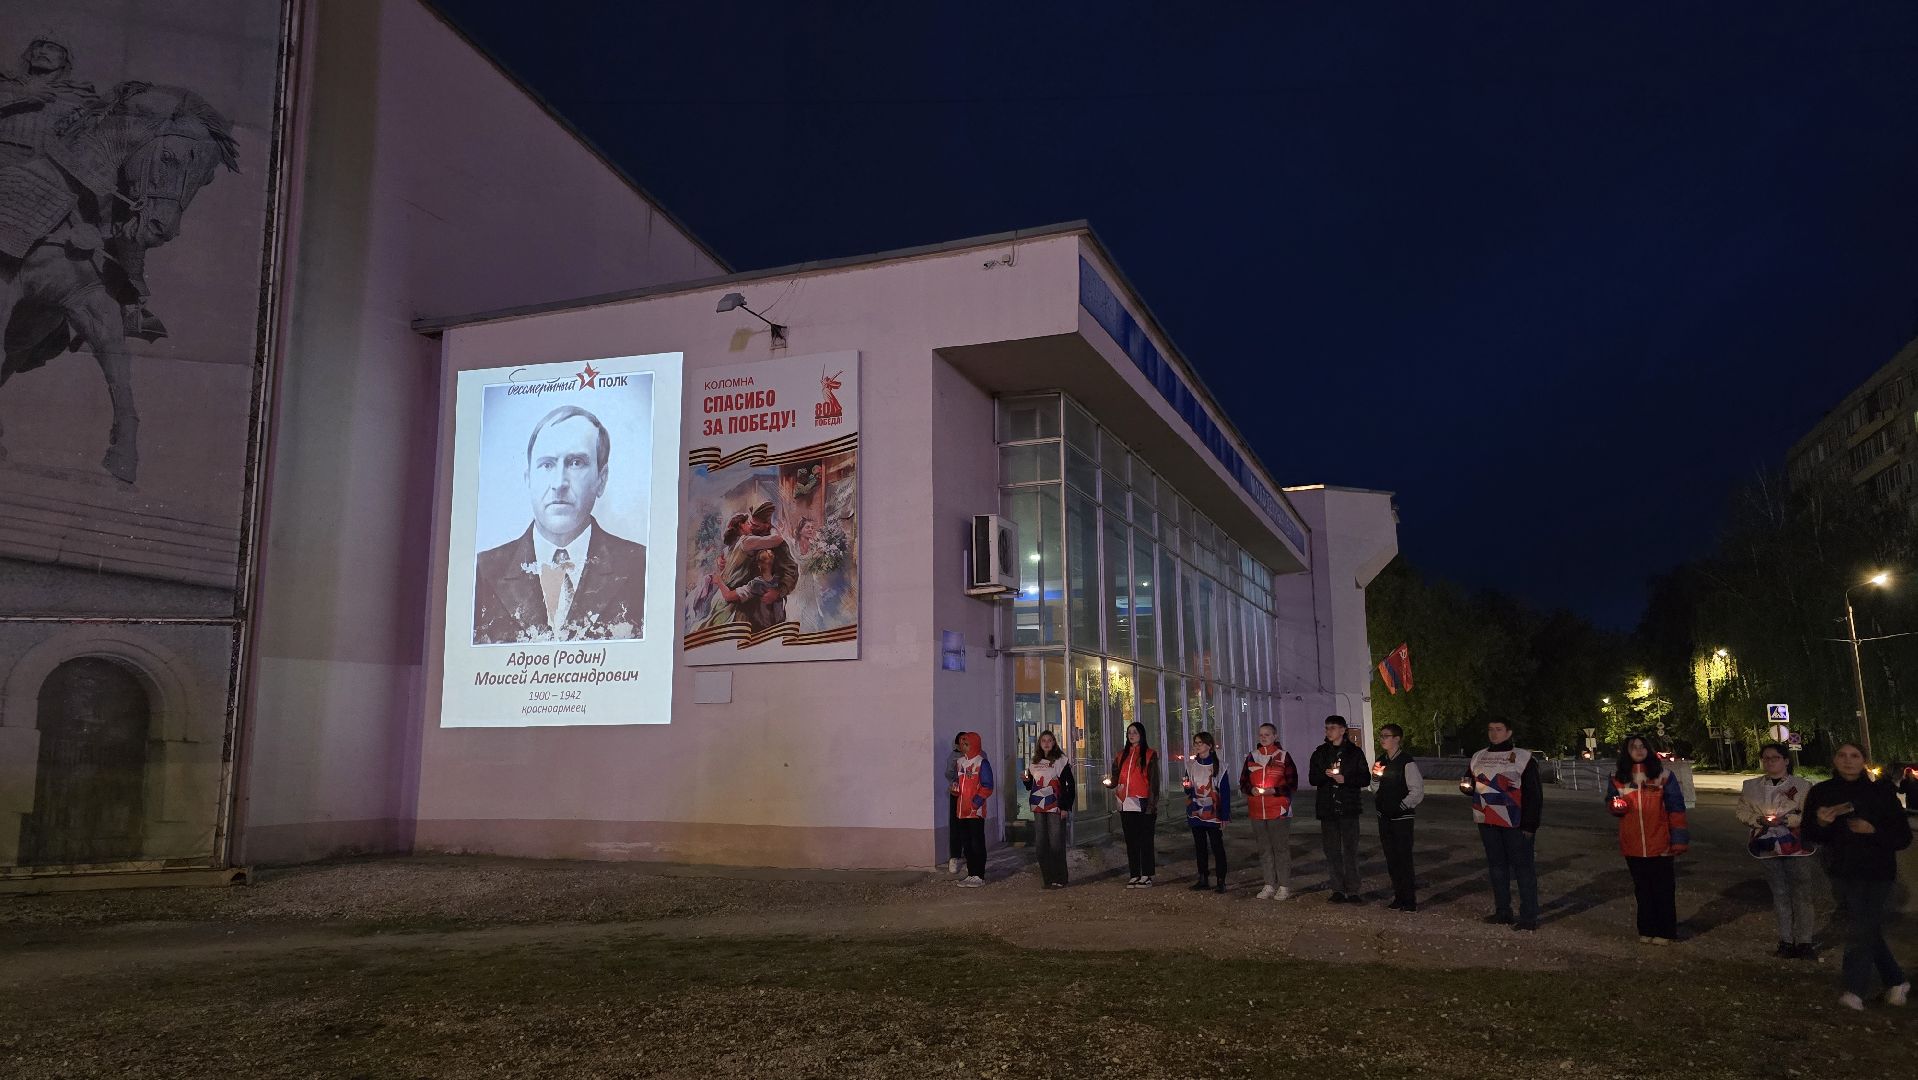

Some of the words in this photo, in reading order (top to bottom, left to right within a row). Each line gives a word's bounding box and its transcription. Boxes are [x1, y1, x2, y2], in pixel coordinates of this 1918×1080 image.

[598, 376, 628, 388] ПОЛК
[704, 376, 754, 391] КОЛОМНА
[703, 389, 776, 414] СПАСИБО
[815, 401, 830, 417] 80
[703, 418, 723, 436] ЗА
[728, 409, 796, 434] ПОБЕДУ!
[506, 651, 550, 669] Адров
[553, 647, 607, 667] (Родин)
[474, 670, 527, 686] Моисей
[530, 667, 639, 686] Александрович
[528, 691, 550, 701] 1900
[560, 690, 582, 700] 1942
[521, 703, 587, 715] красноармеец
